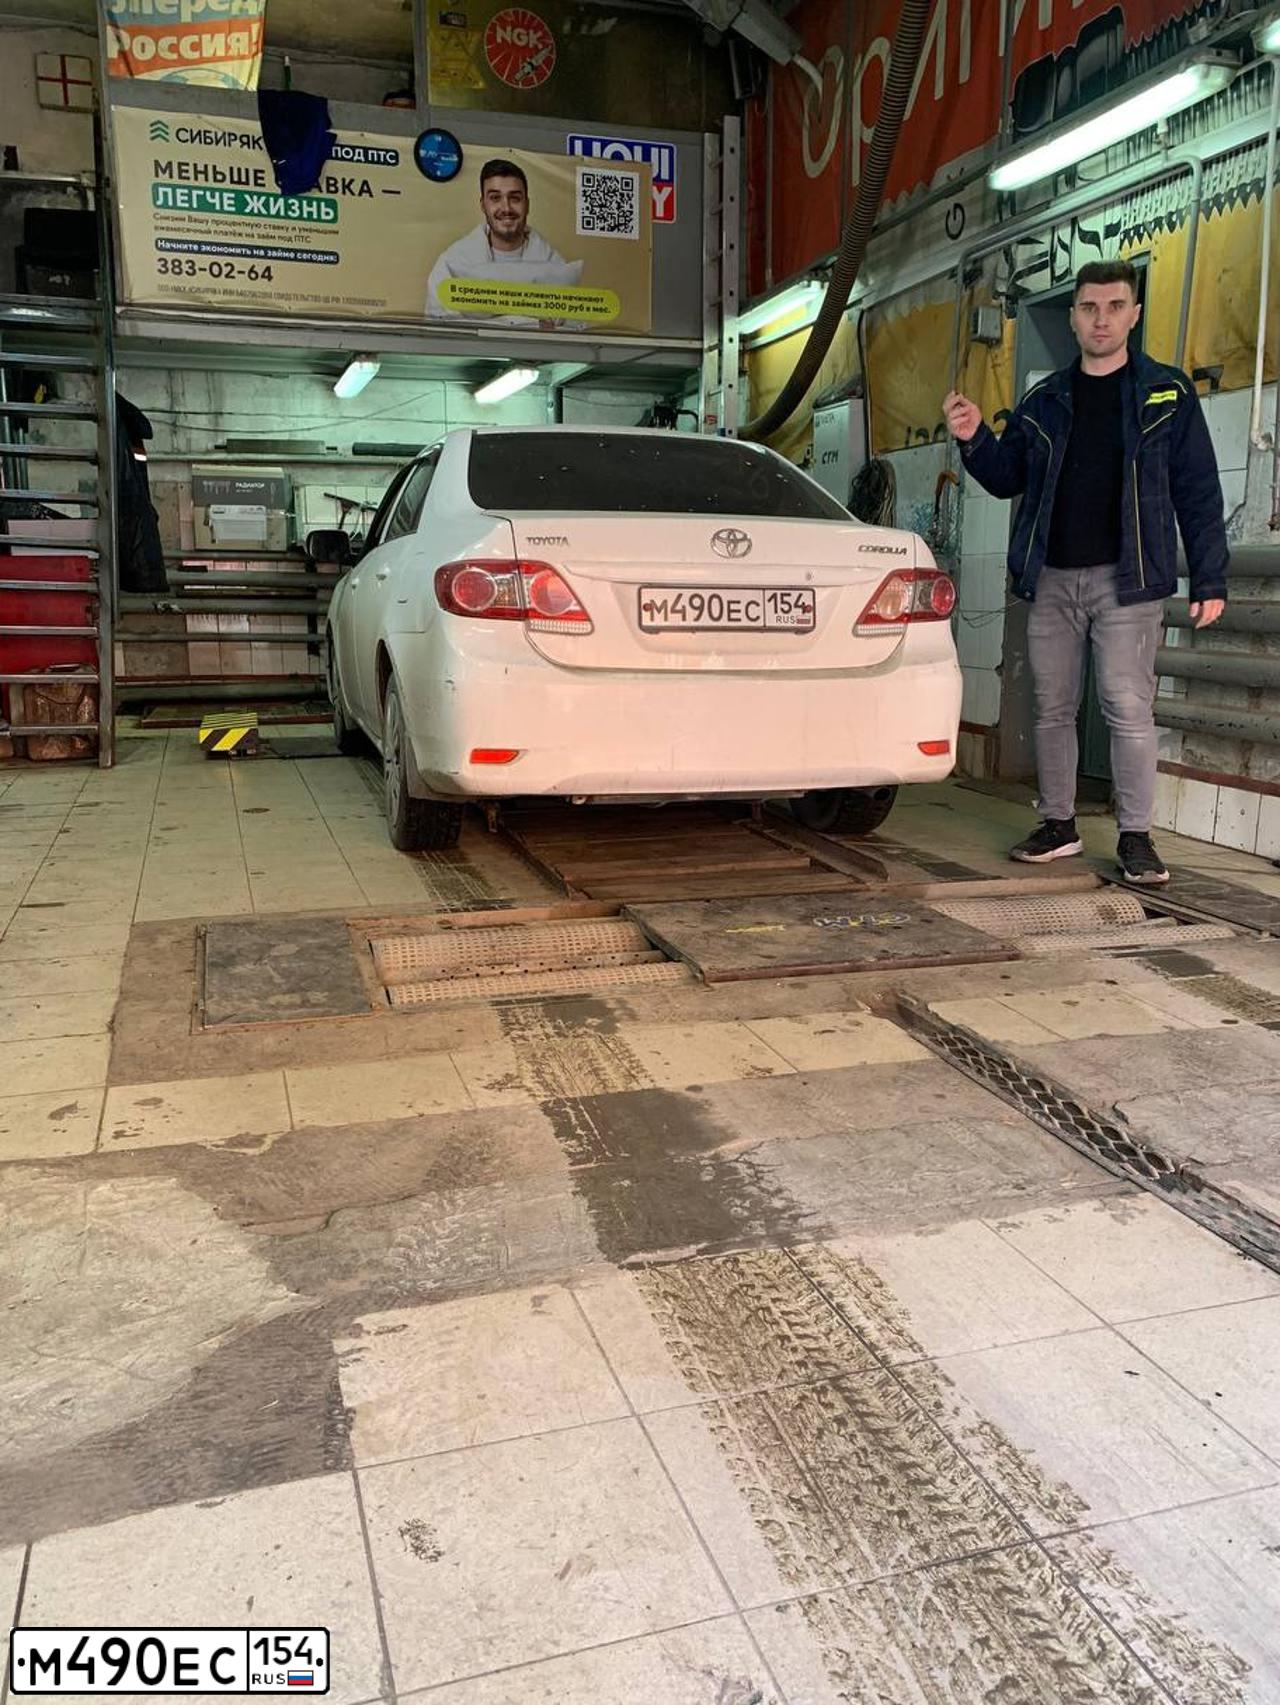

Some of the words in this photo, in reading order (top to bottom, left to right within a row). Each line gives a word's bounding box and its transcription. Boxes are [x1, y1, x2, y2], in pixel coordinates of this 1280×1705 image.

[111, 0, 257, 23] перед
[495, 25, 543, 49] NGK
[175, 127, 264, 150] СИБИРЯК
[332, 146, 365, 162] ПОД
[368, 149, 397, 163] ПТС
[153, 160, 266, 187] МЕНЬШЕ
[313, 176, 374, 198] ВКА
[155, 186, 236, 212] ЛЕГЧЕ
[244, 195, 335, 221] ЖИЗНЬ
[157, 240, 199, 251] Начните
[201, 244, 250, 256] экономить
[253, 249, 265, 257] на
[294, 235, 312, 244] ПТС
[157, 257, 274, 282] 383-02-64
[526, 536, 569, 546] TOYOTA
[858, 545, 908, 555] COROLLA
[649, 593, 760, 622] М490ЕС
[767, 592, 807, 614] 154
[775, 615, 796, 624] RUS
